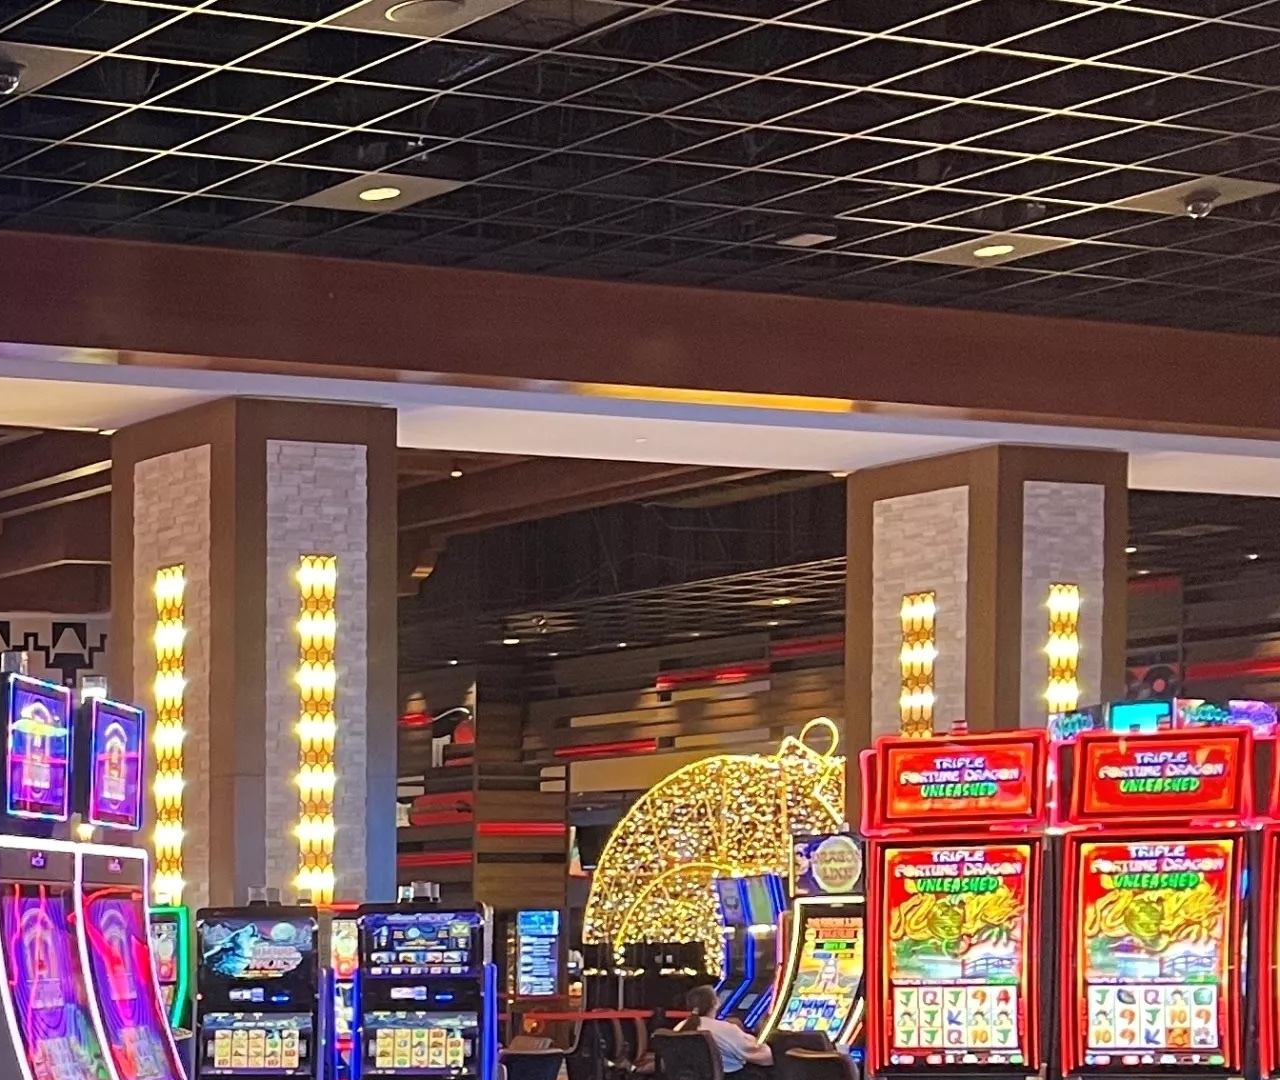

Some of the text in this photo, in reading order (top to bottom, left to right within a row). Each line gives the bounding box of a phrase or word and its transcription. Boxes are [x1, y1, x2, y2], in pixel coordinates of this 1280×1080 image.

[934, 757, 984, 769] TRIPLE
[1134, 752, 1187, 763] TRIPLE
[900, 769, 1019, 784] FORTUNE DRAGON
[1099, 764, 1223, 778] FORTUNE DRAGON
[921, 783, 997, 797] UNLEASHED
[1120, 778, 1200, 793] UNLEASHED
[931, 851, 984, 863] TRIPLE
[1128, 845, 1186, 857] TRIPLE
[895, 863, 1021, 877] FORTUNE DRAGON
[1091, 858, 1224, 873] FORTUNE DRAGON
[916, 877, 998, 892] UNLEASHED
[1113, 873, 1200, 888] UNLEASHED
